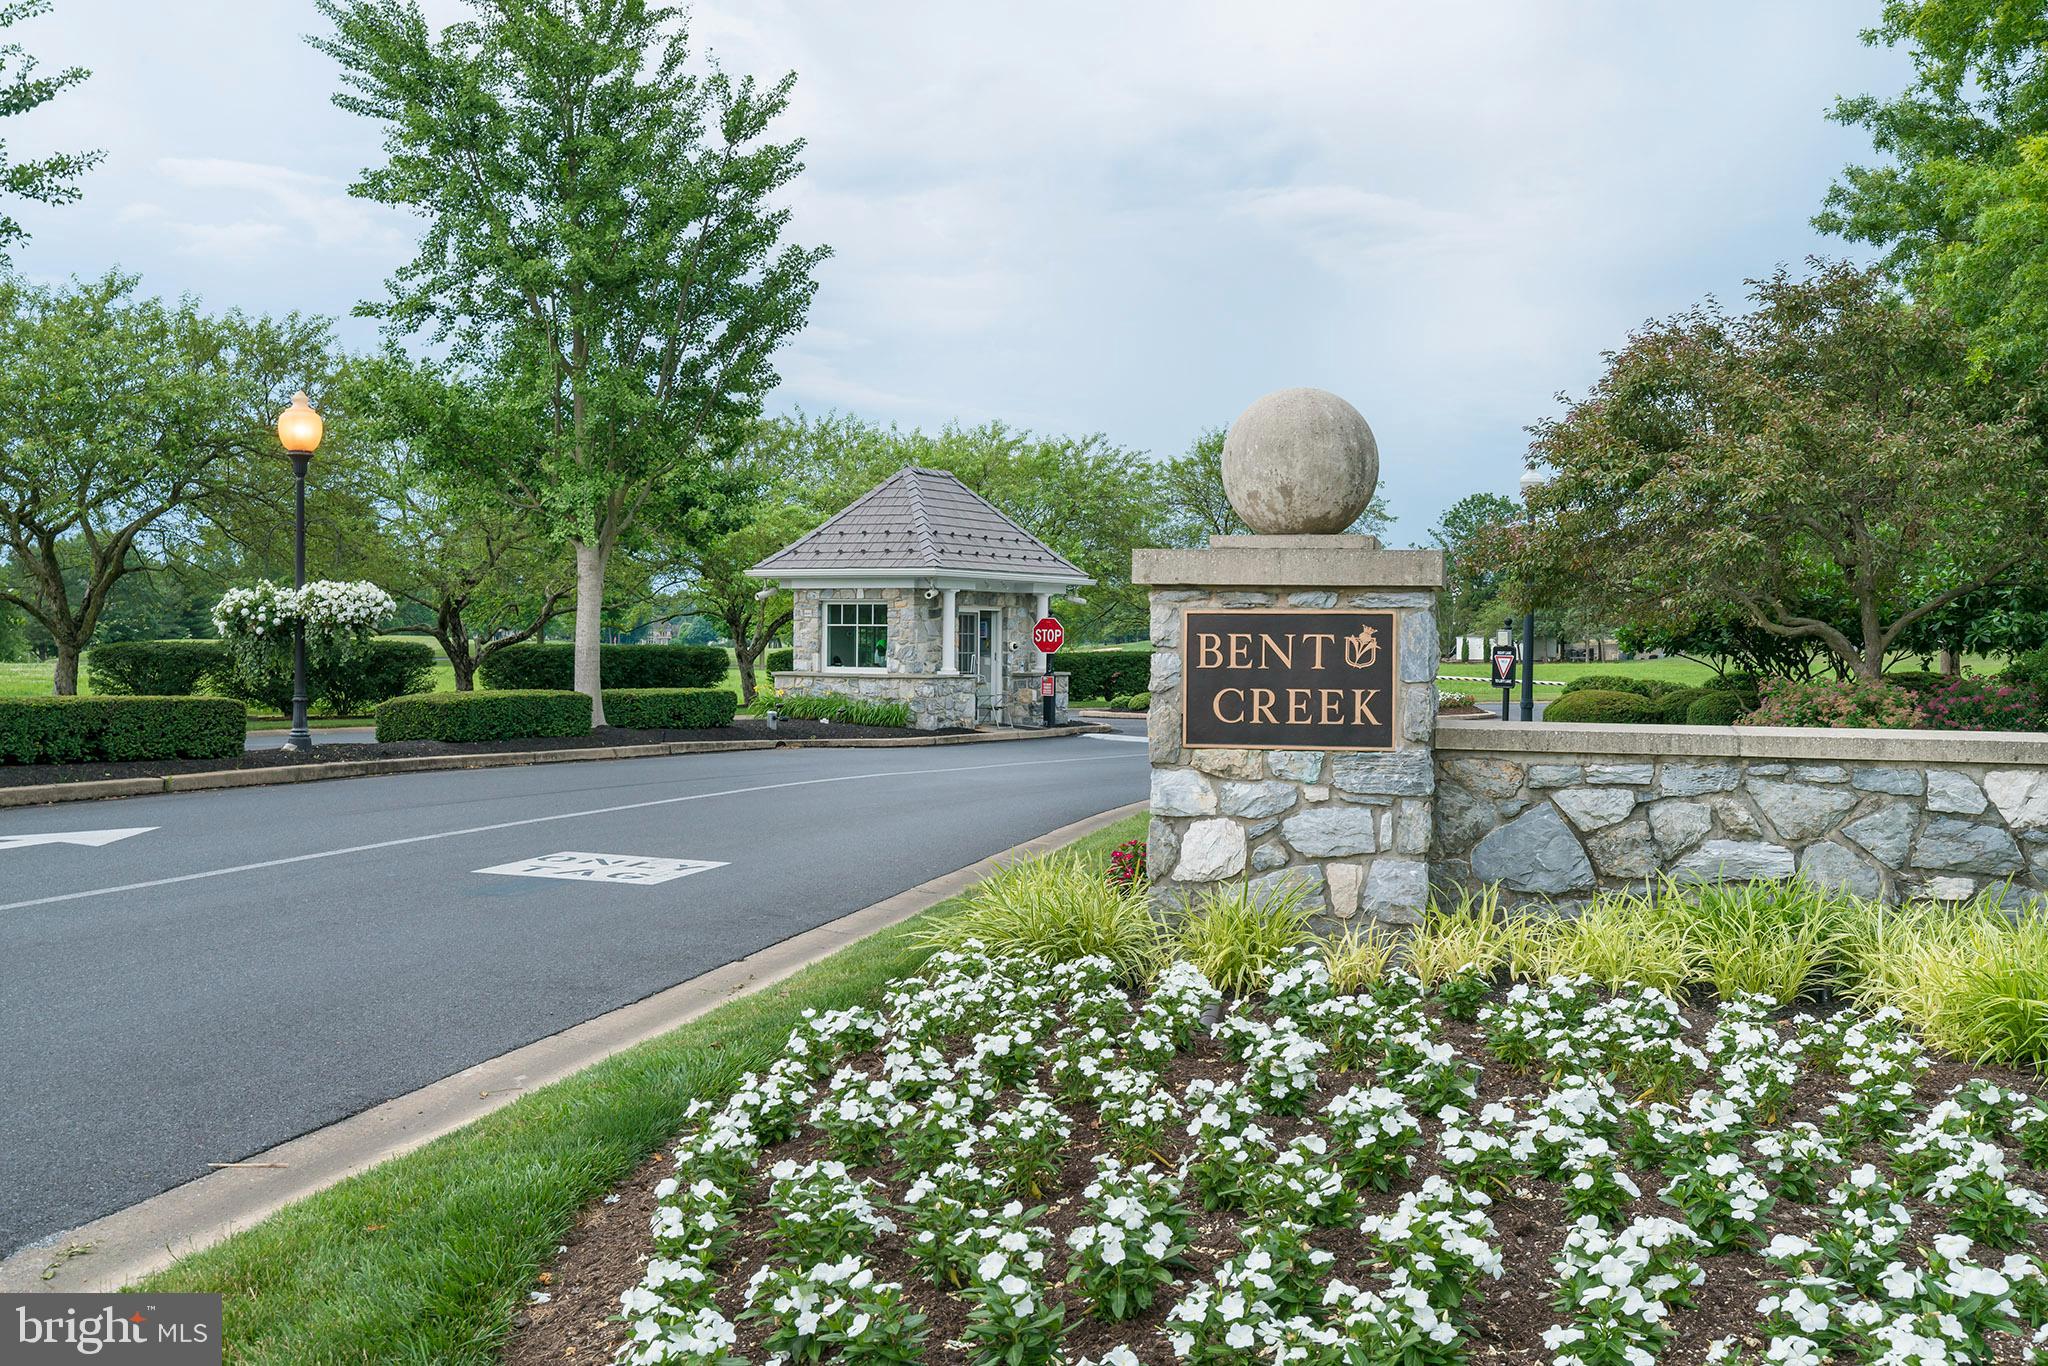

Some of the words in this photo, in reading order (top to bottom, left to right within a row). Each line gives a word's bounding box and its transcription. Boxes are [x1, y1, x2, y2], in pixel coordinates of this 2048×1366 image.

[1035, 629, 1062, 643] STOP
[1196, 633, 1335, 670] BENT
[1212, 687, 1383, 726] CREEK
[537, 855, 707, 871] ONLY
[522, 865, 651, 880] TAG
